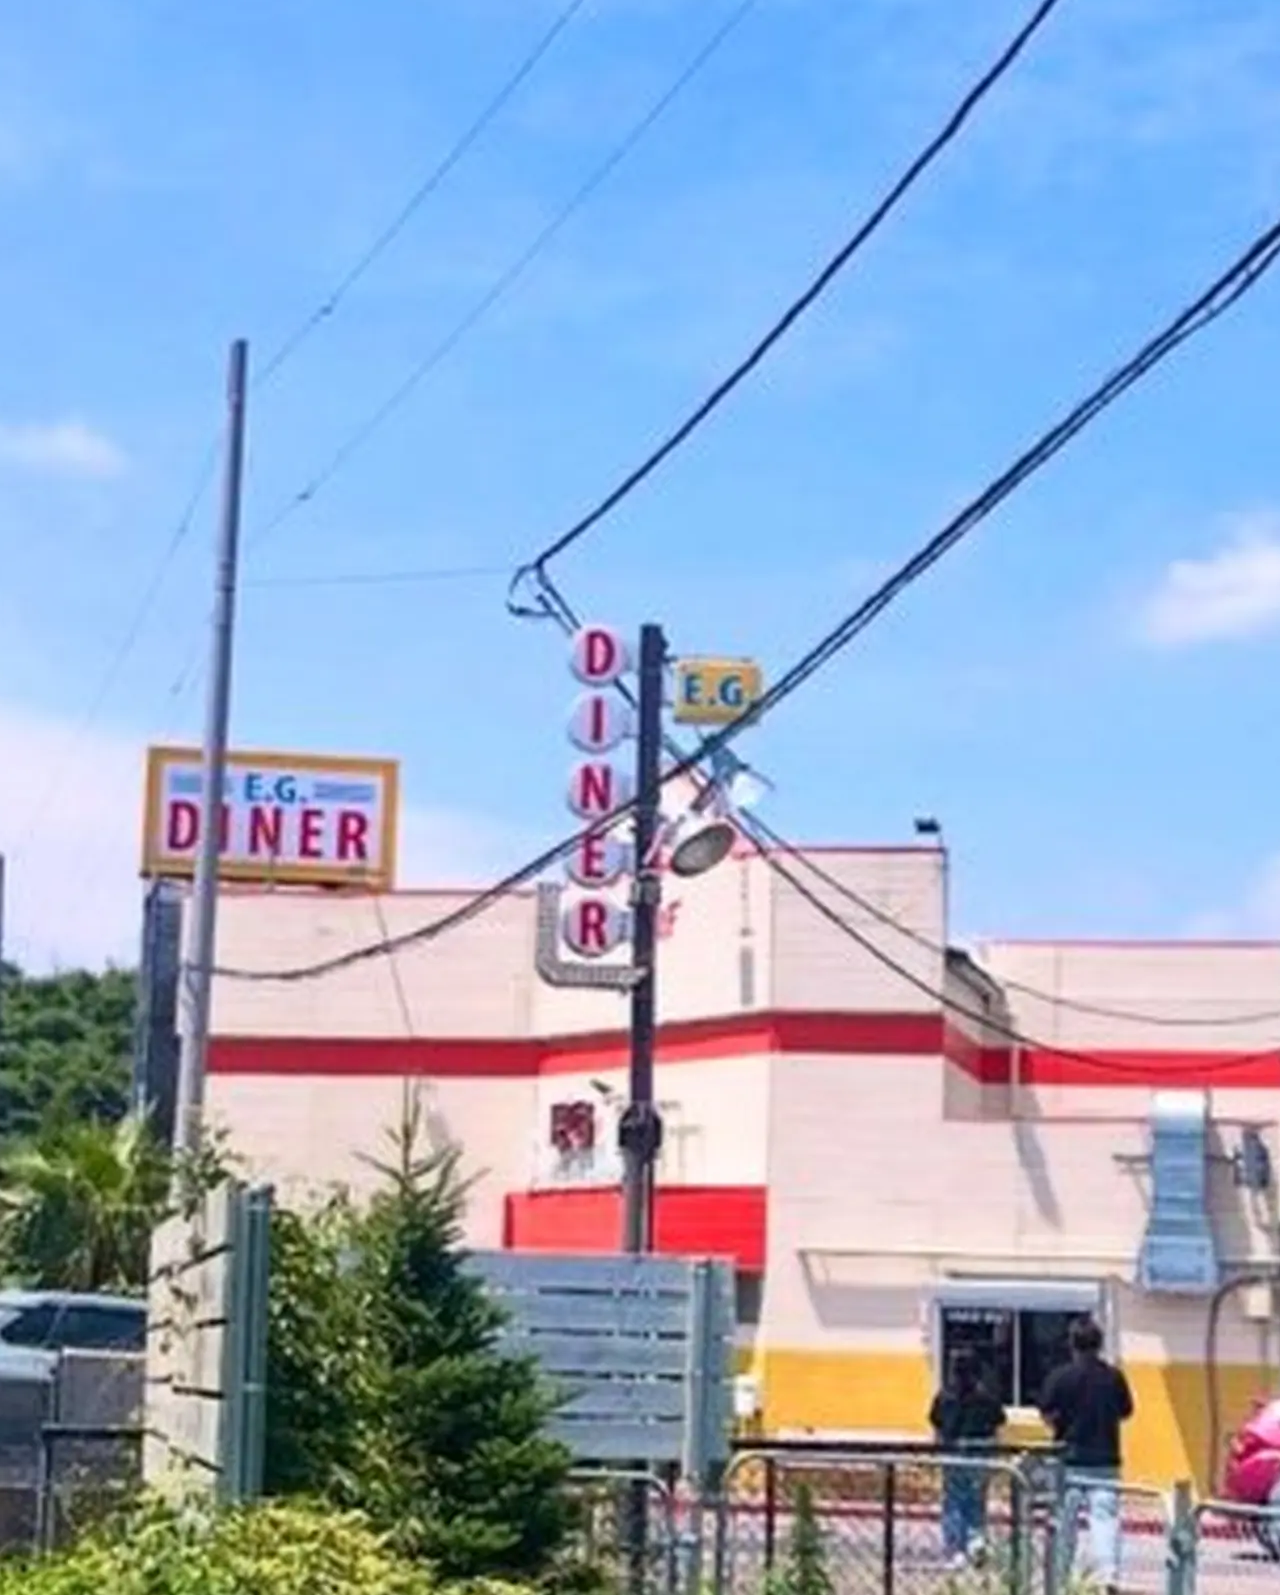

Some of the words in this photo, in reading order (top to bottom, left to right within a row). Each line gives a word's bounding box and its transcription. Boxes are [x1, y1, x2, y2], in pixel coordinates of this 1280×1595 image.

[244, 773, 308, 803] E.G.
[579, 630, 616, 947] DINER
[168, 802, 368, 860] DINER
